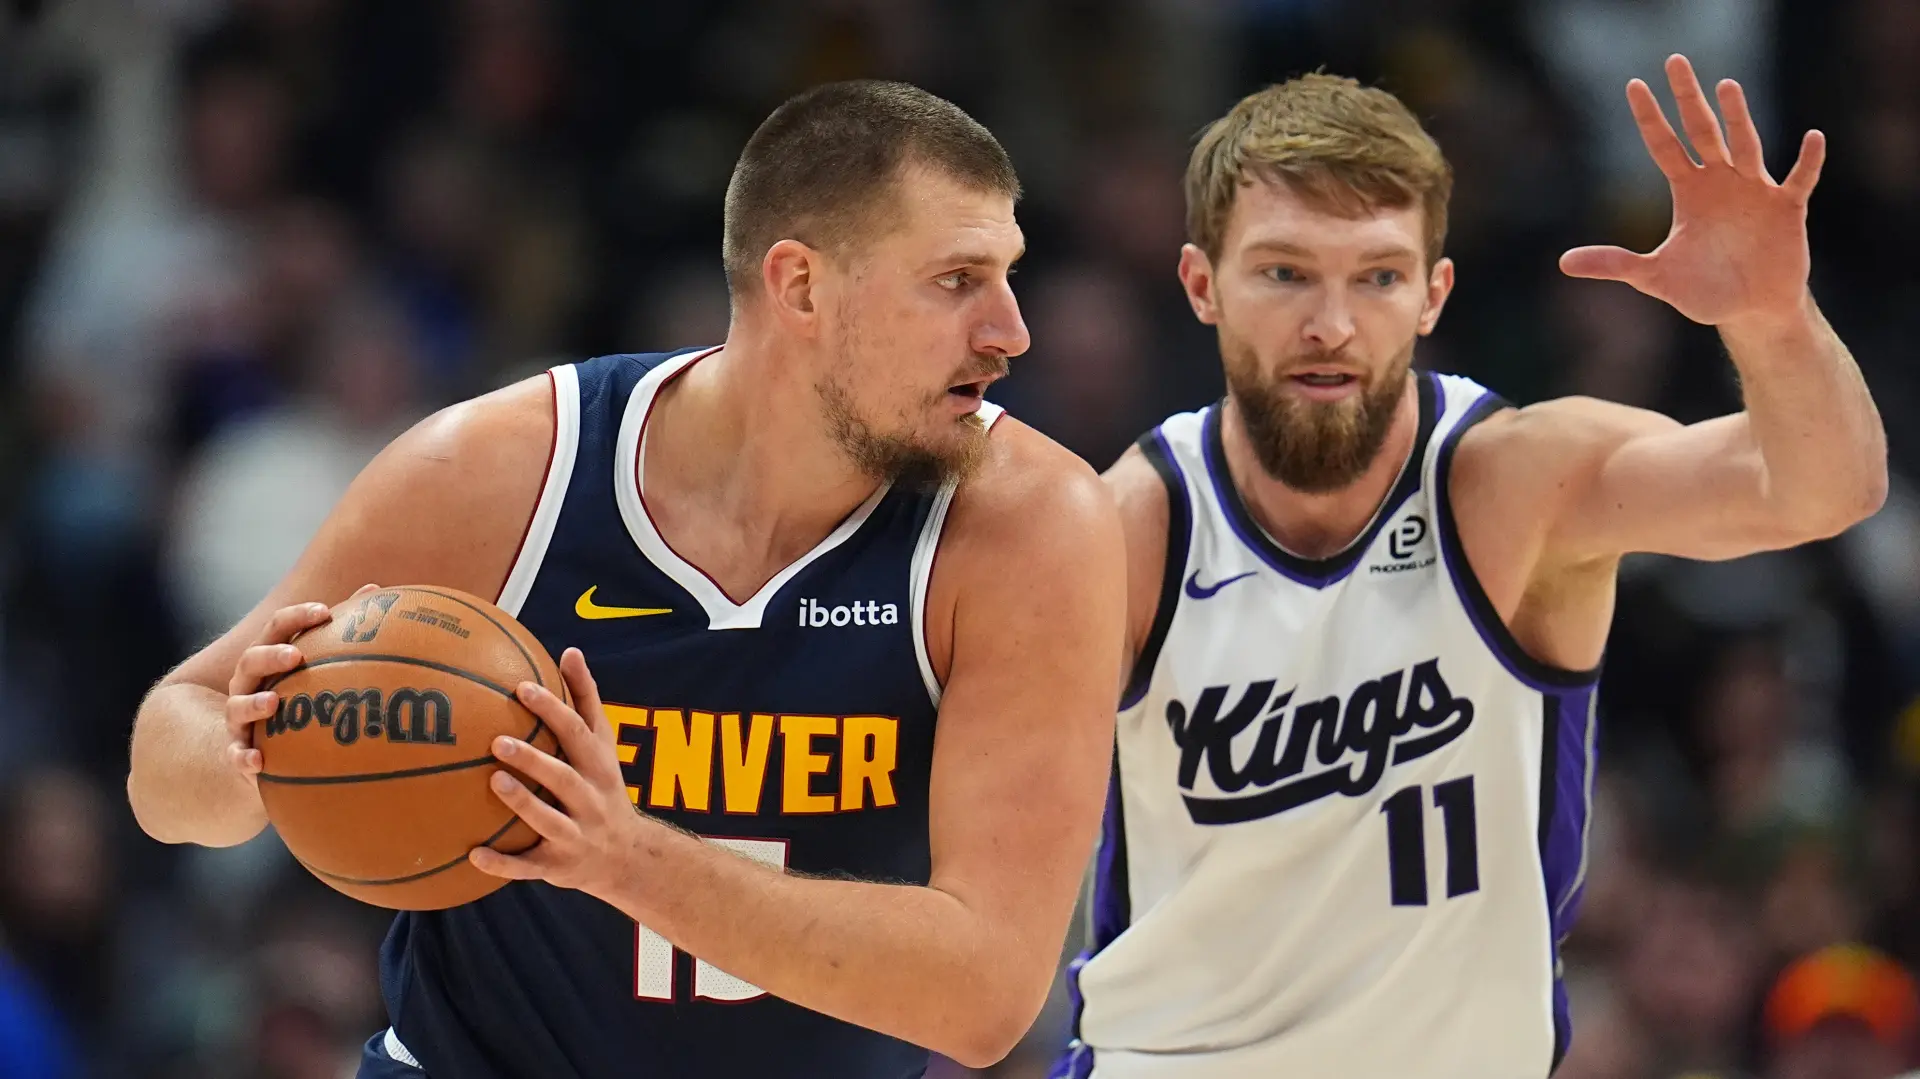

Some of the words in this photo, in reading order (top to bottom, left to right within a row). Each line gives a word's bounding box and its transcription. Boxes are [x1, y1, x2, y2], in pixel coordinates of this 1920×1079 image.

[439, 619, 470, 639] OFFICIAL
[799, 598, 898, 628] ibotta
[266, 687, 457, 746] Wilson
[599, 701, 900, 817] ENVER
[1166, 656, 1474, 825] Kings
[1379, 774, 1480, 906] 11
